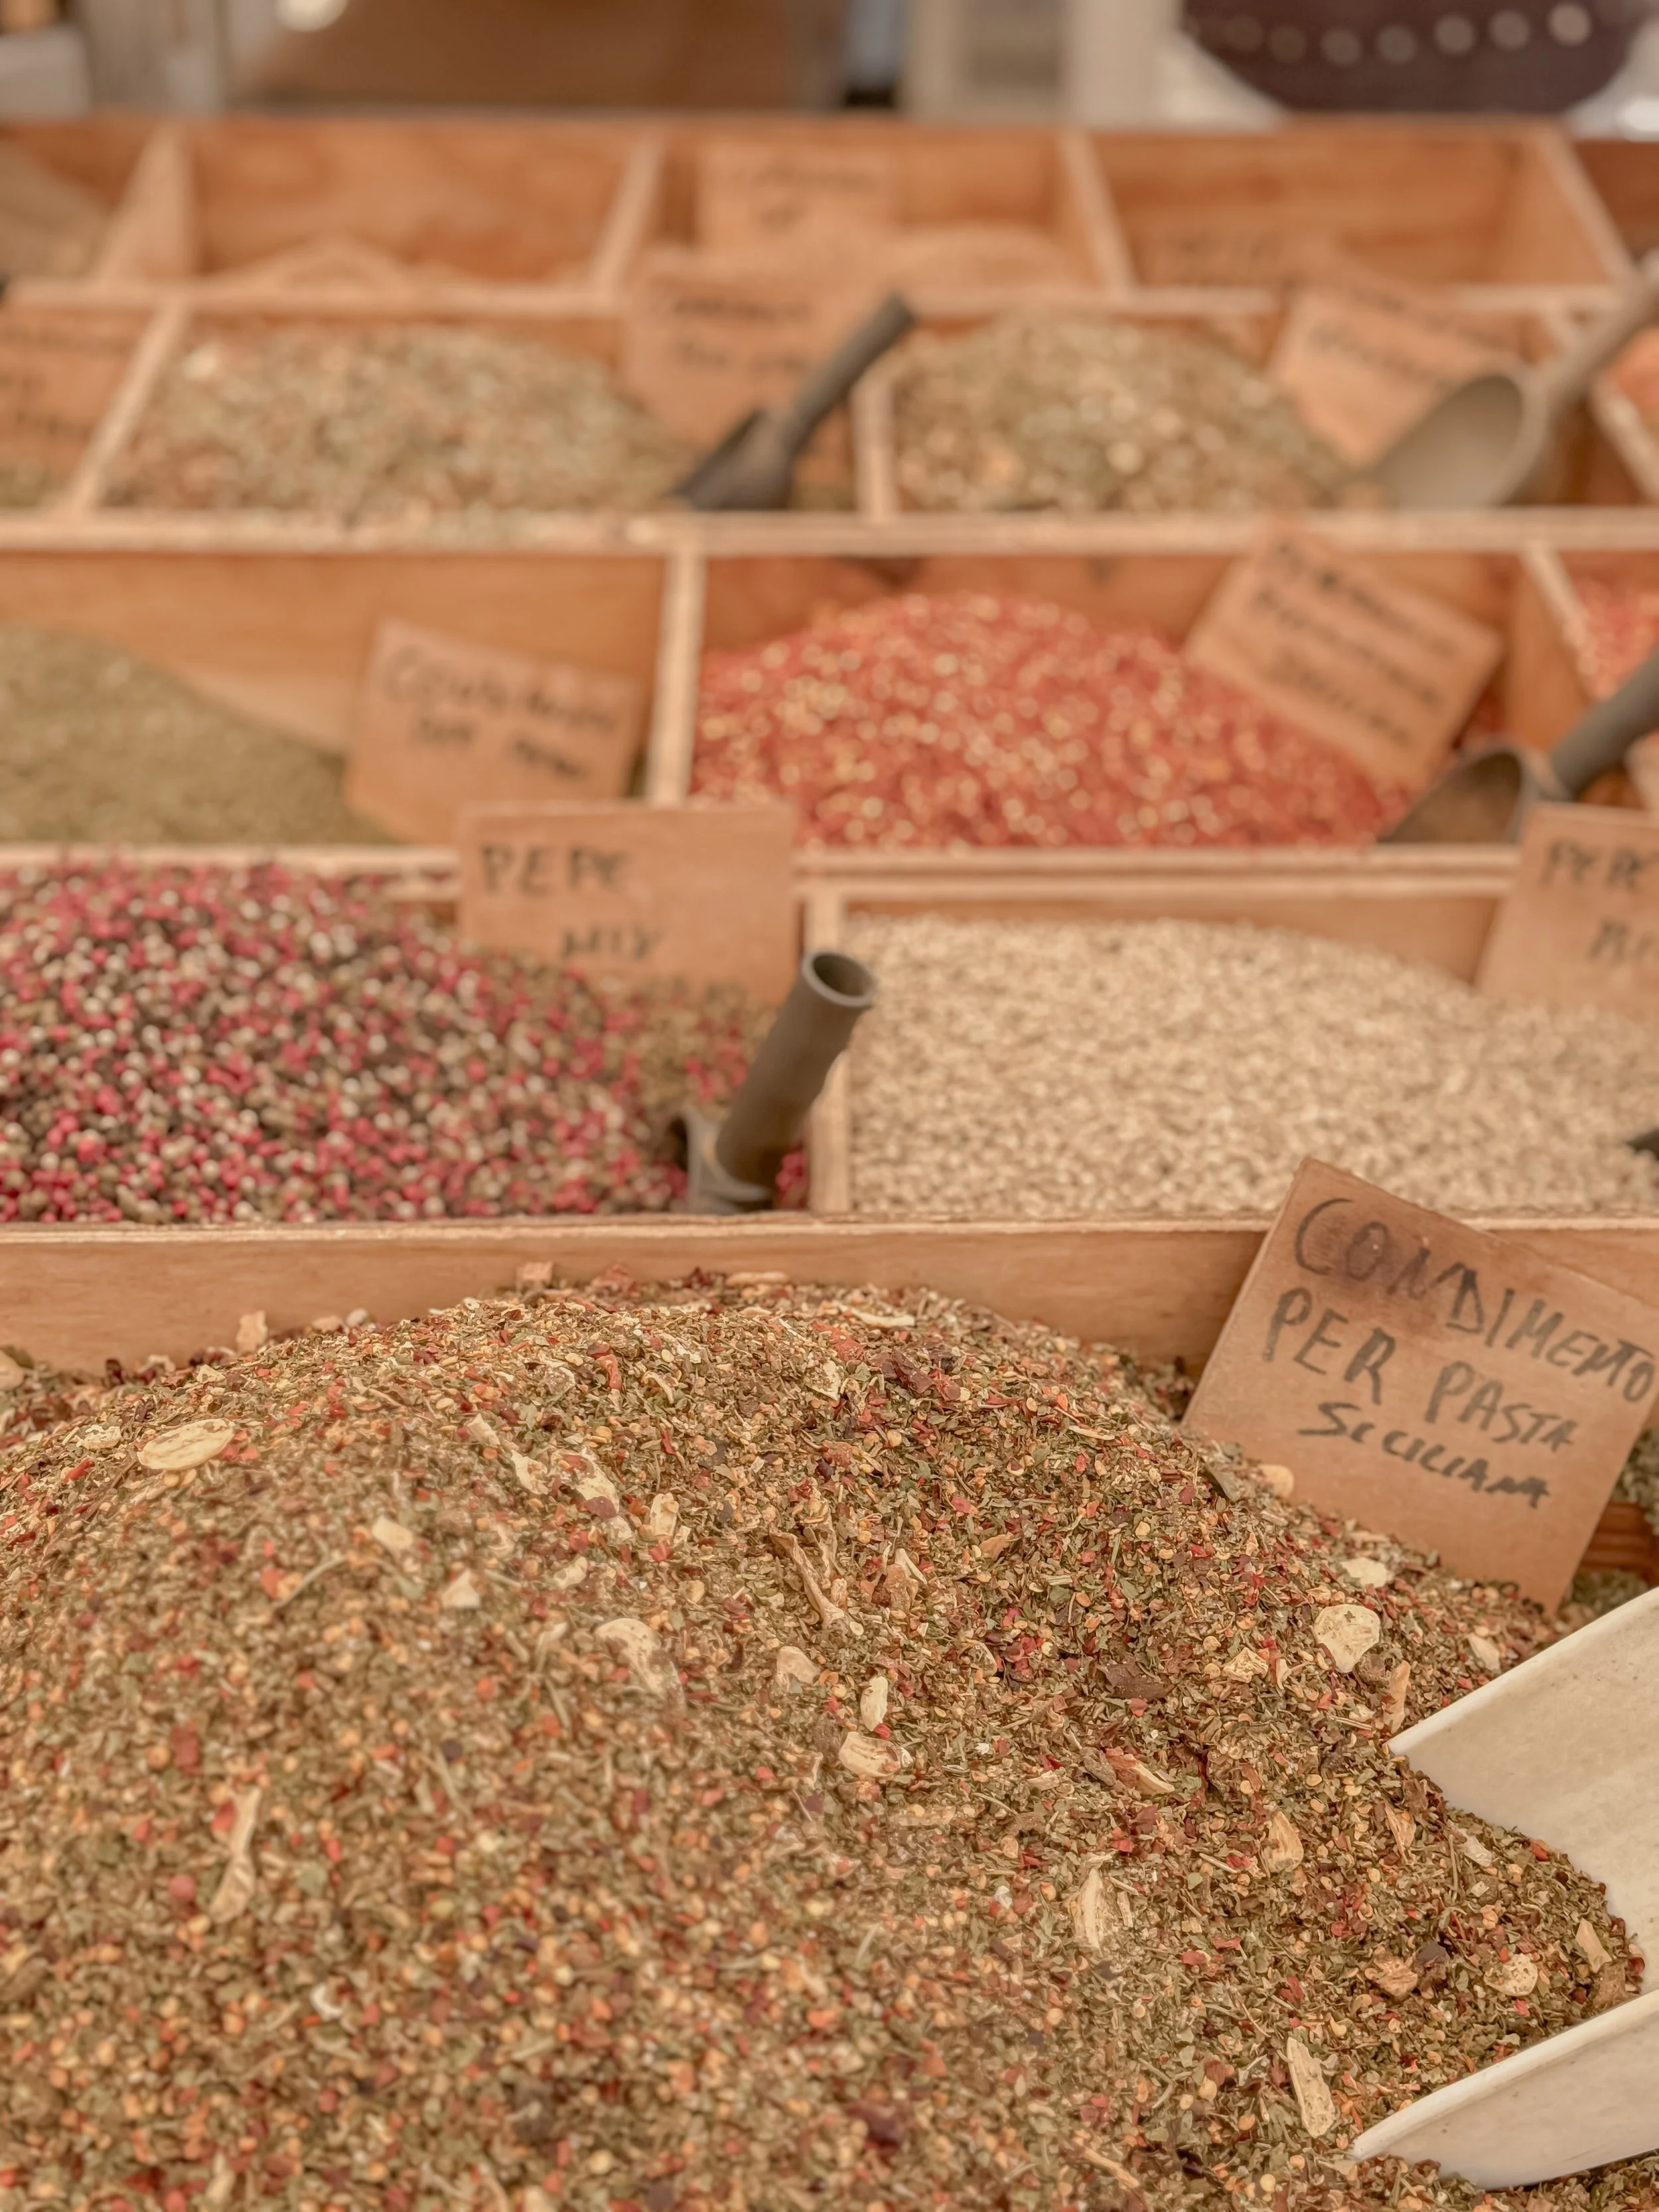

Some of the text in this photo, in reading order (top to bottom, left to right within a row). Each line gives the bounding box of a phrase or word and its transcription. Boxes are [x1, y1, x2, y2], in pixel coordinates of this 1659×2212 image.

[1260, 1286, 1579, 1453] PER PASTA
[1294, 1197, 1656, 1404] CONDIMENTO
